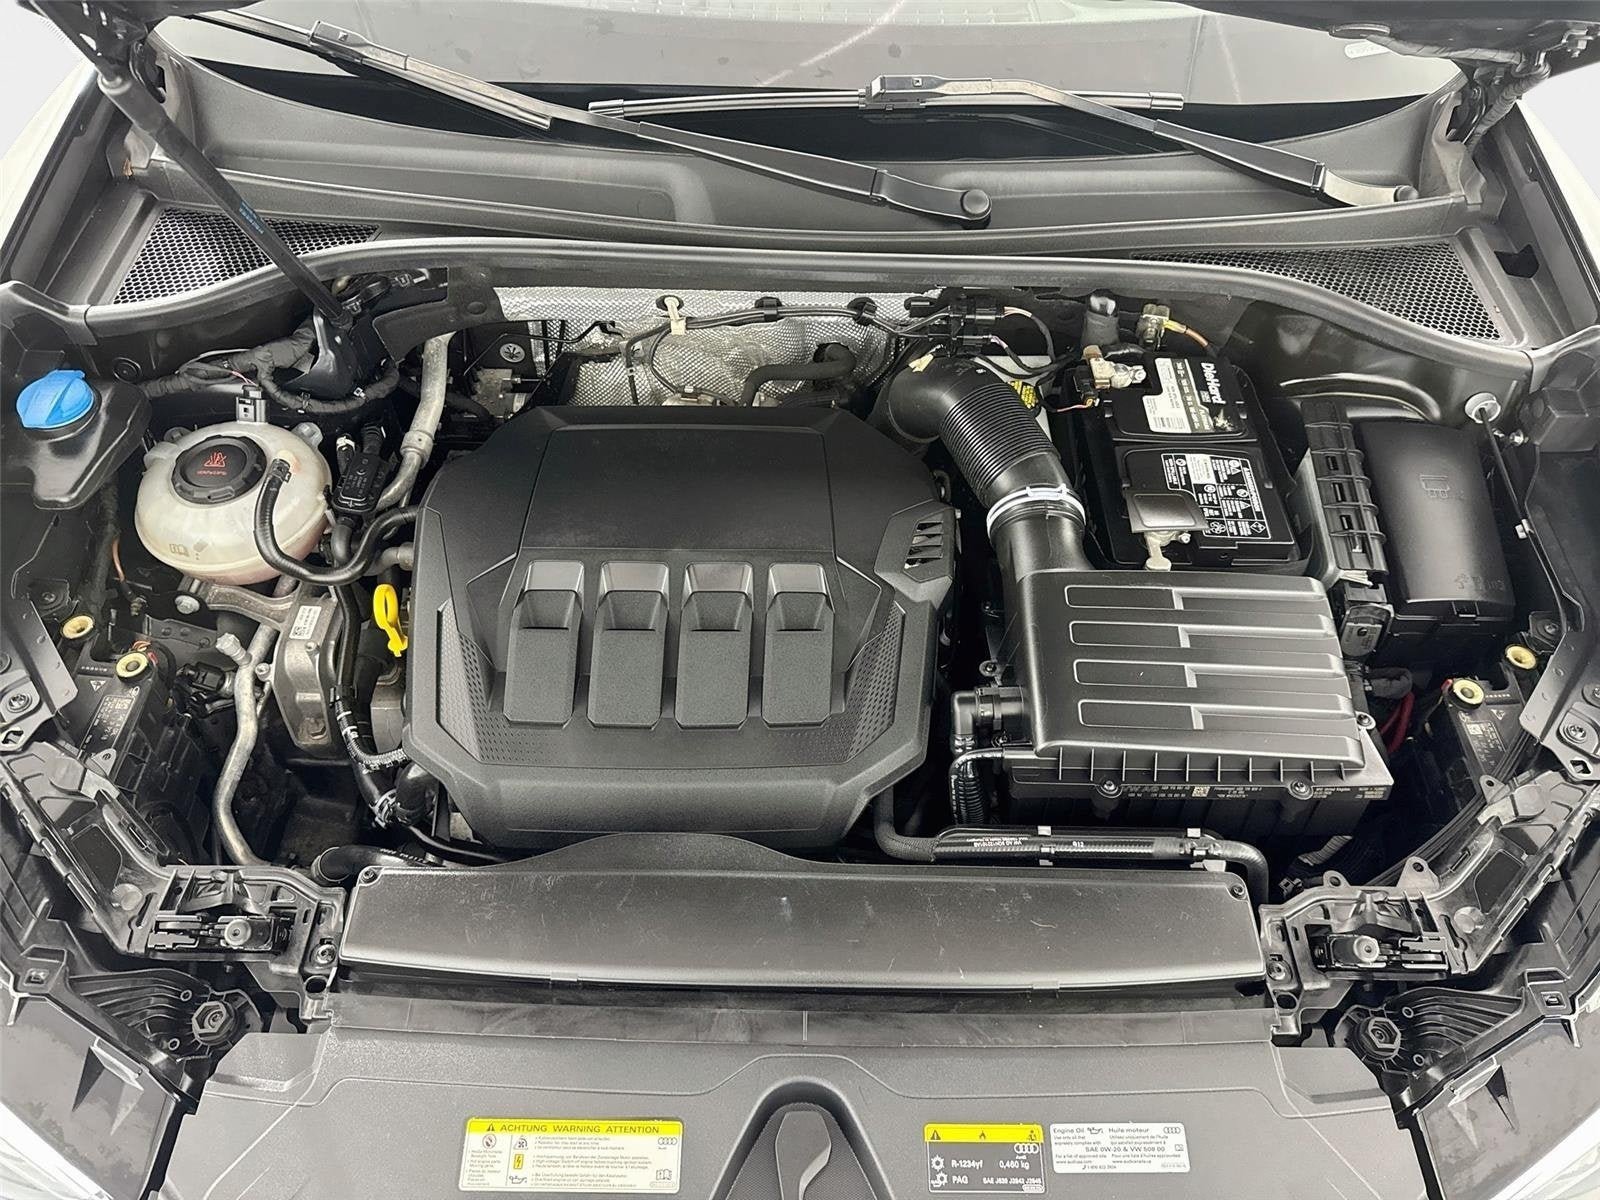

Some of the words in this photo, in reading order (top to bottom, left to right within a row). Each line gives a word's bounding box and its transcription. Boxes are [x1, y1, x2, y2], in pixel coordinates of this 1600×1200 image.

[1200, 362, 1226, 404] DieHard
[951, 1159, 983, 1170] R-1234yf
[1020, 1160, 1030, 1170] kg
